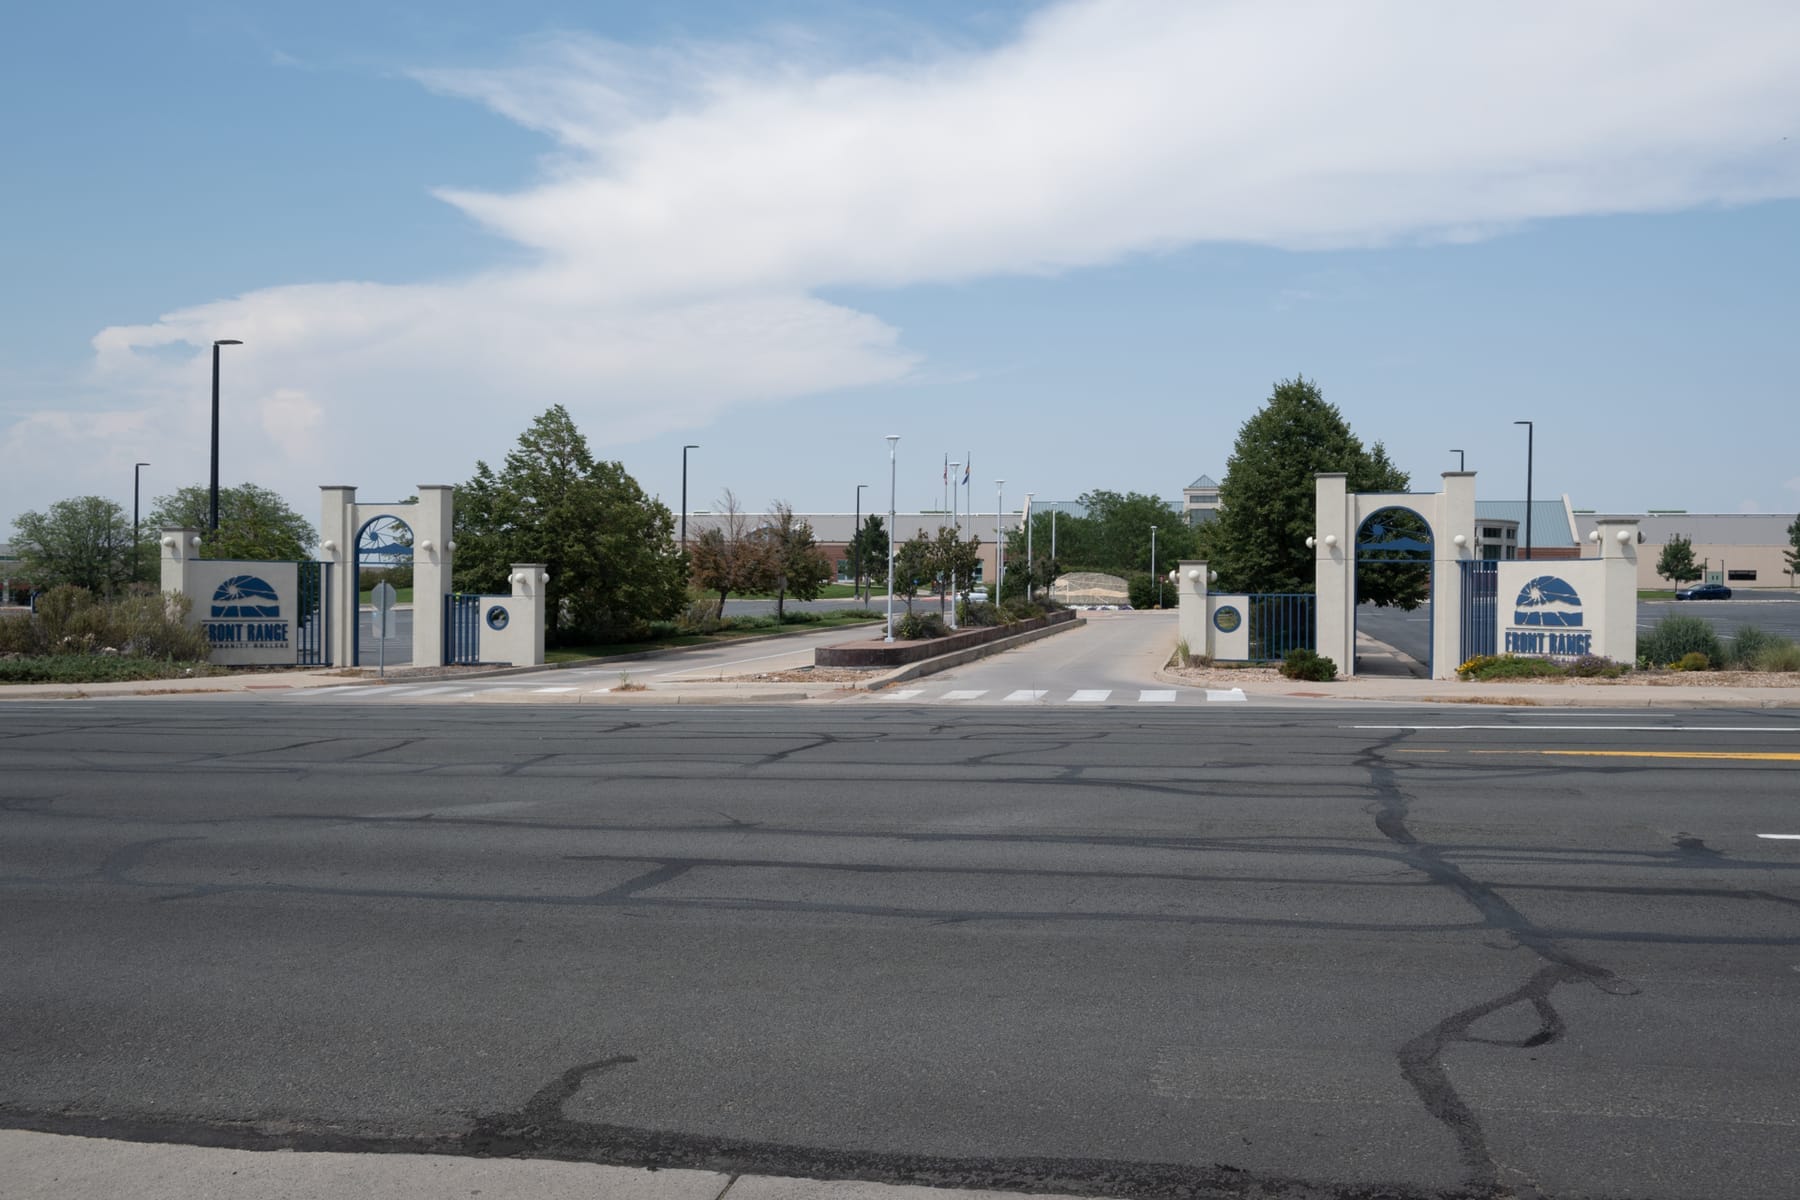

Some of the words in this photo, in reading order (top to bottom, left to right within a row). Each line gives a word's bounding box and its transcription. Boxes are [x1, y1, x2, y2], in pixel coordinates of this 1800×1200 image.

[247, 624, 288, 641] RANGE
[1505, 632, 1544, 653] FRONT
[1549, 633, 1592, 656] RANGE
